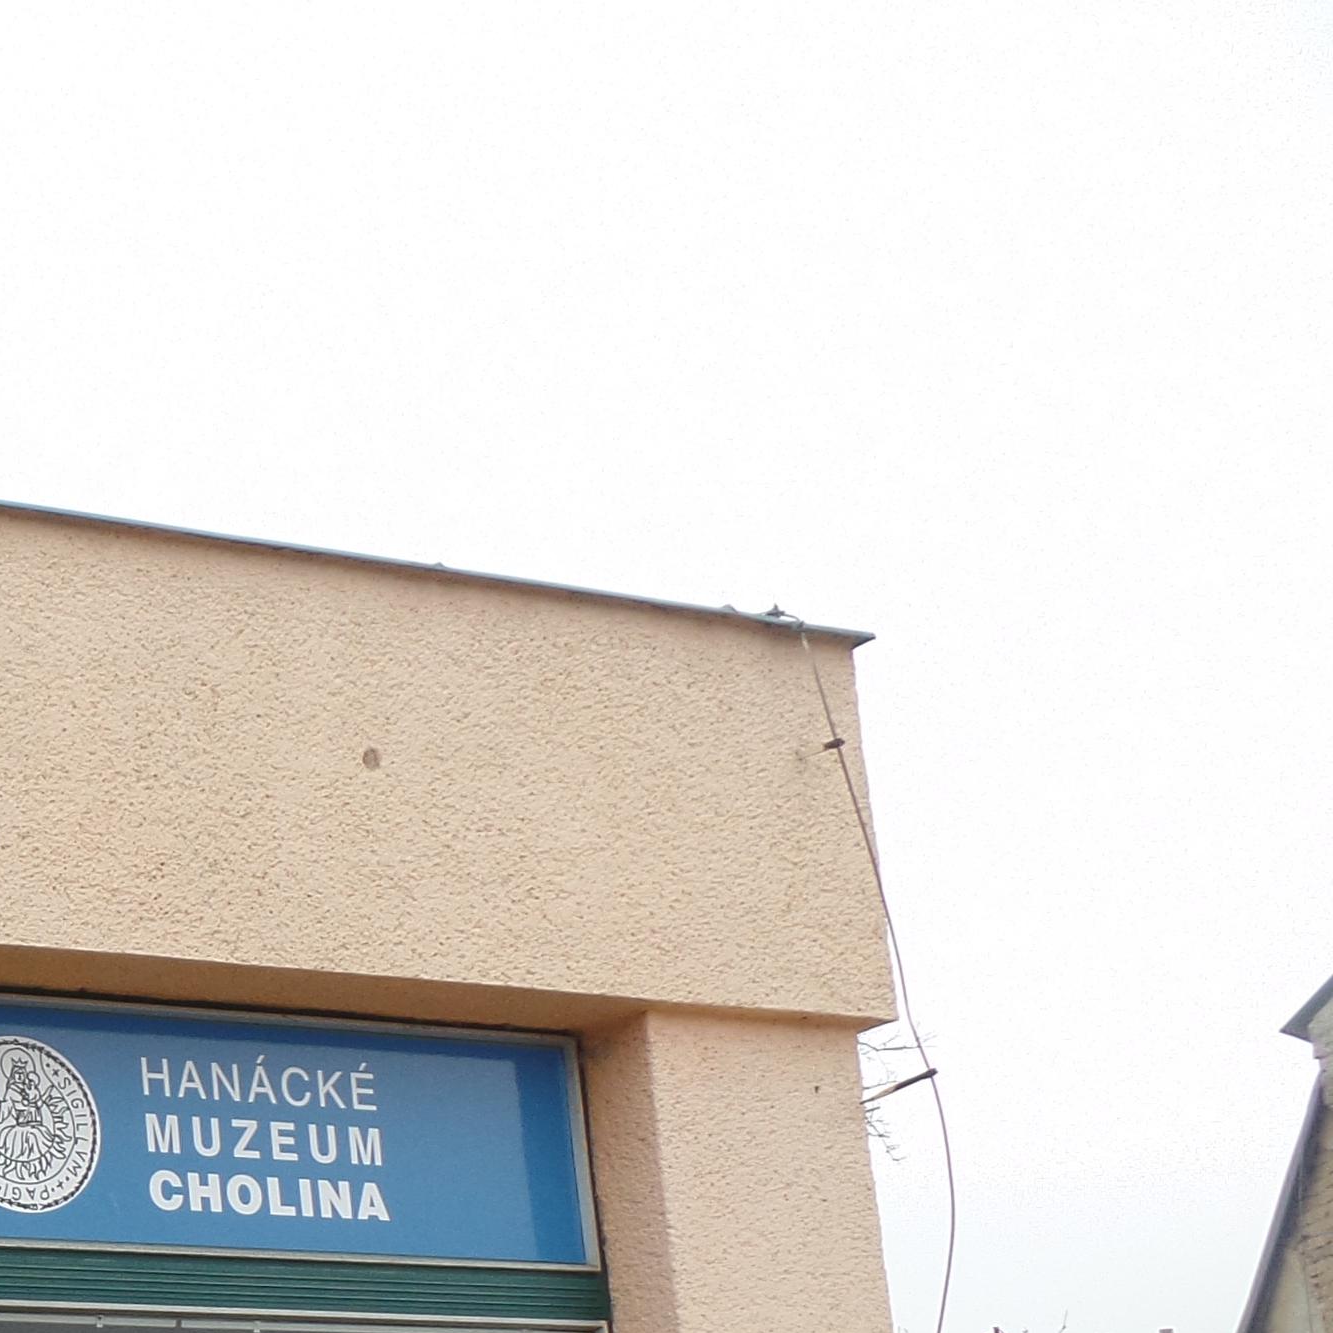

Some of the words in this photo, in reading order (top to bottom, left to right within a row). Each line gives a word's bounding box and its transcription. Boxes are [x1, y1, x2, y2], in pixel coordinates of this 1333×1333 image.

[140, 1055, 378, 1112] HANÁCKÉ
[145, 1113, 383, 1168] MUZEUM
[149, 1170, 391, 1222] CHOLINA
